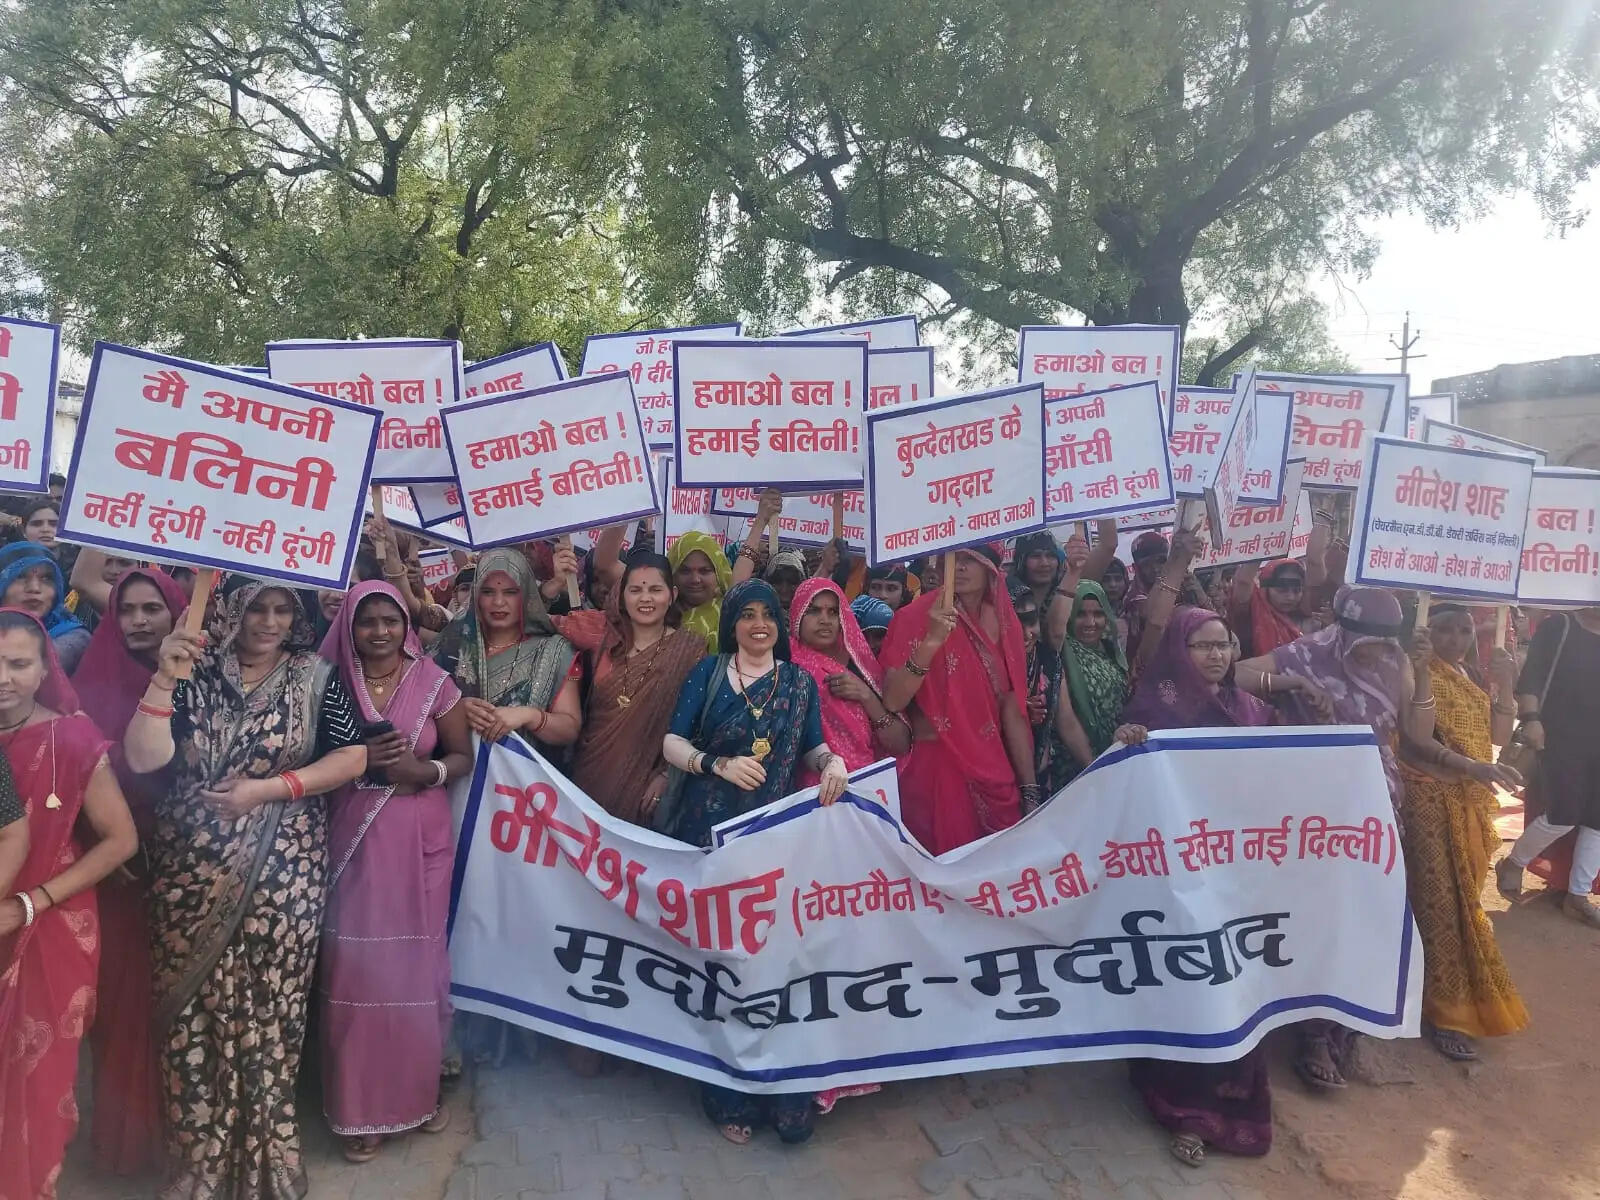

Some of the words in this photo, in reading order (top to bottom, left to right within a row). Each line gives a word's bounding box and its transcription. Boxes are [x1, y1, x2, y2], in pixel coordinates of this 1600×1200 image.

[1034, 349, 1104, 375] हमाओ
[1112, 355, 1147, 374] बल
[289, 373, 374, 405] माओ
[381, 380, 424, 404] बल
[693, 373, 782, 409] हमाओ
[790, 381, 834, 405] बल
[844, 380, 852, 407] !
[1294, 390, 1364, 409] अपनी
[201, 390, 335, 443] अपनी
[999, 404, 1022, 440] के
[1056, 397, 1105, 425] अपनी
[377, 417, 442, 449] लिनी
[465, 419, 557, 470] हमाओ
[562, 416, 609, 446] बल
[616, 411, 627, 439] !
[686, 419, 762, 456] हमाई
[115, 427, 337, 512] बलिनी
[927, 468, 994, 507] गद्दार
[1122, 468, 1160, 499] दूंगी
[469, 468, 544, 517] हमाई
[1395, 465, 1462, 513] मीनेश
[1464, 483, 1509, 520] शाह
[149, 500, 207, 543] दूंगी
[281, 526, 336, 569] दूंगी
[800, 519, 830, 535] जाओ
[885, 528, 919, 551] वापस
[922, 515, 955, 542] जाओ
[968, 509, 1001, 531] वापस
[1003, 497, 1035, 523] जाओ
[1537, 508, 1578, 531] बल
[1369, 544, 1393, 570] होश
[1394, 546, 1408, 571] में
[1408, 551, 1439, 574] आओ
[1470, 556, 1483, 579] में
[1483, 560, 1513, 582] आओ
[656, 868, 784, 955] शाह
[1099, 828, 1169, 879] डेयरी
[1241, 815, 1293, 866] नई
